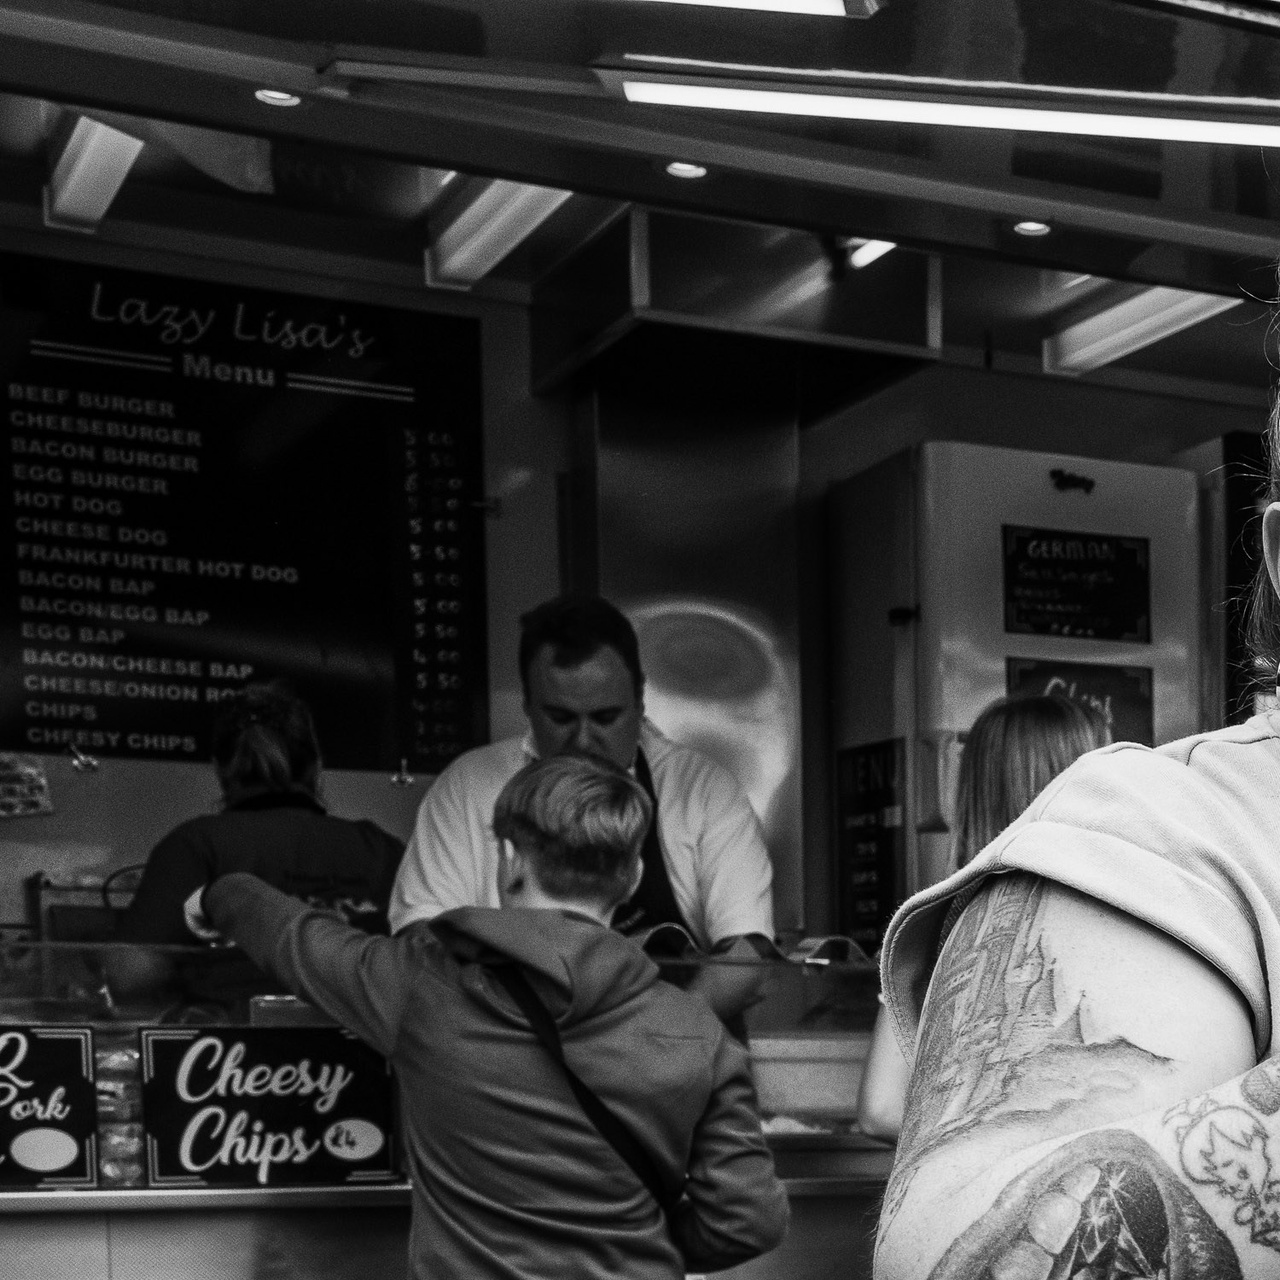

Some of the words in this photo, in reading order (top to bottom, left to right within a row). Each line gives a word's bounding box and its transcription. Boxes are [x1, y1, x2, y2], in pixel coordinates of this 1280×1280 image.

[90, 282, 216, 344] Lazy
[233, 302, 376, 358] Lisa's
[182, 353, 276, 387] Menu
[7, 382, 69, 405] BEEF
[77, 390, 175, 418] BURGER
[9, 409, 202, 447] CHEESEBURGER
[11, 436, 96, 461] BACON
[102, 445, 199, 472] BURGER
[12, 462, 64, 484] EGG
[70, 468, 168, 495] BURGER
[13, 489, 64, 510] HOT
[71, 495, 123, 516] DOG
[15, 516, 110, 541] CHEESE
[117, 525, 168, 546] DOG
[17, 542, 191, 573] FRANKFURTER
[197, 558, 245, 578] HOT
[250, 563, 299, 584] DOG
[18, 568, 102, 592] BACON
[108, 576, 156, 596] BAP
[21, 622, 72, 642] EGG
[78, 626, 126, 644] BAP
[164, 607, 210, 627] BAP
[209, 661, 253, 679] BAP
[24, 699, 98, 721] CHIPS
[126, 731, 197, 753] CHIPS
[176, 1037, 354, 1113] Cheesy
[179, 1106, 320, 1184] Chips
